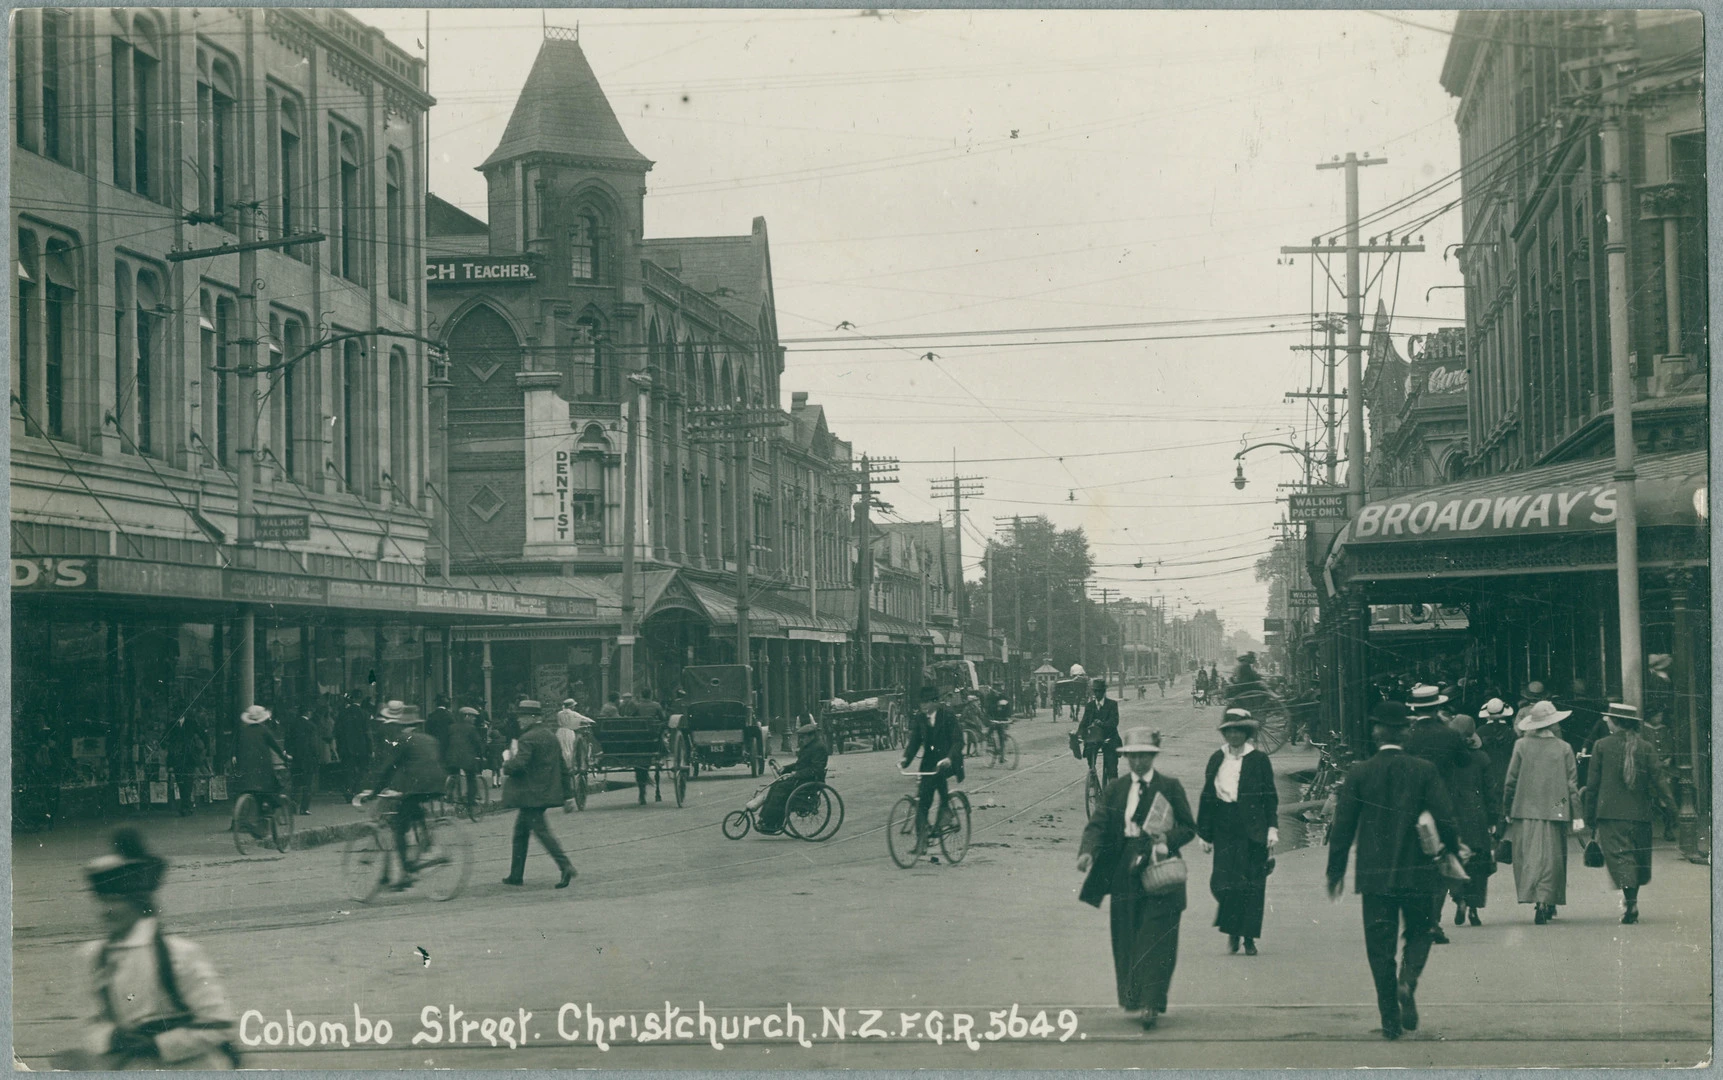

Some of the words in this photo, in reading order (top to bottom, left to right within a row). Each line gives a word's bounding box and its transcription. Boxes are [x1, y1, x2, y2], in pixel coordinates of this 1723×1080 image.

[462, 262, 534, 279] TEACHER.
[556, 450, 569, 540] DENTIST
[1295, 496, 1342, 506] WALKING
[1291, 507, 1317, 518] PACE
[1318, 506, 1345, 517] ONLY
[1355, 486, 1618, 538] BROADWAY'S
[259, 518, 304, 527] WALKING
[255, 529, 280, 537] PACE
[281, 528, 306, 537] ONLY
[11, 557, 87, 587] D'S
[1292, 591, 1317, 599] WALKIN
